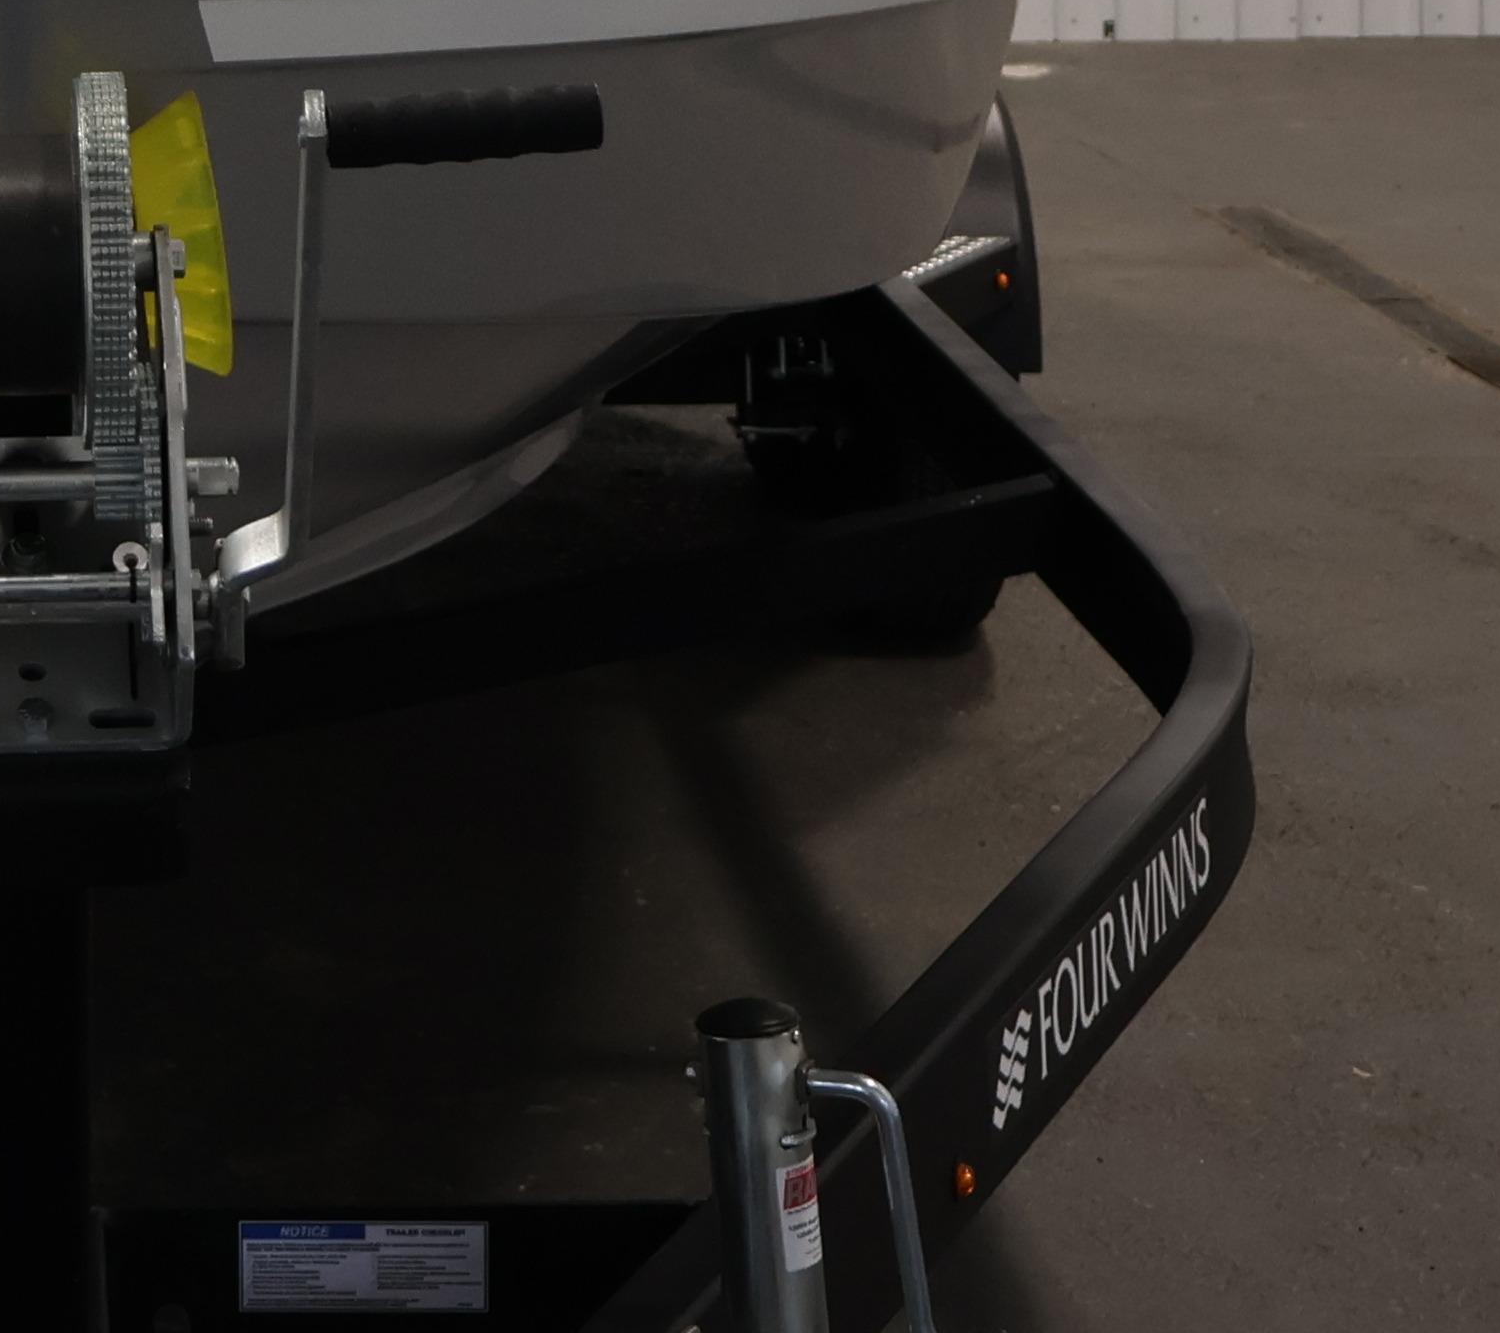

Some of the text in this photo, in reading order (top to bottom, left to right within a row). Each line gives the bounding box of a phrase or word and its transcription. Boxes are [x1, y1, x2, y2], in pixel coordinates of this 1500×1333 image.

[1038, 797, 1210, 1080] FOUR WINNS
[279, 1224, 330, 1238] NOTICE
[385, 1228, 419, 1237] TRAILER
